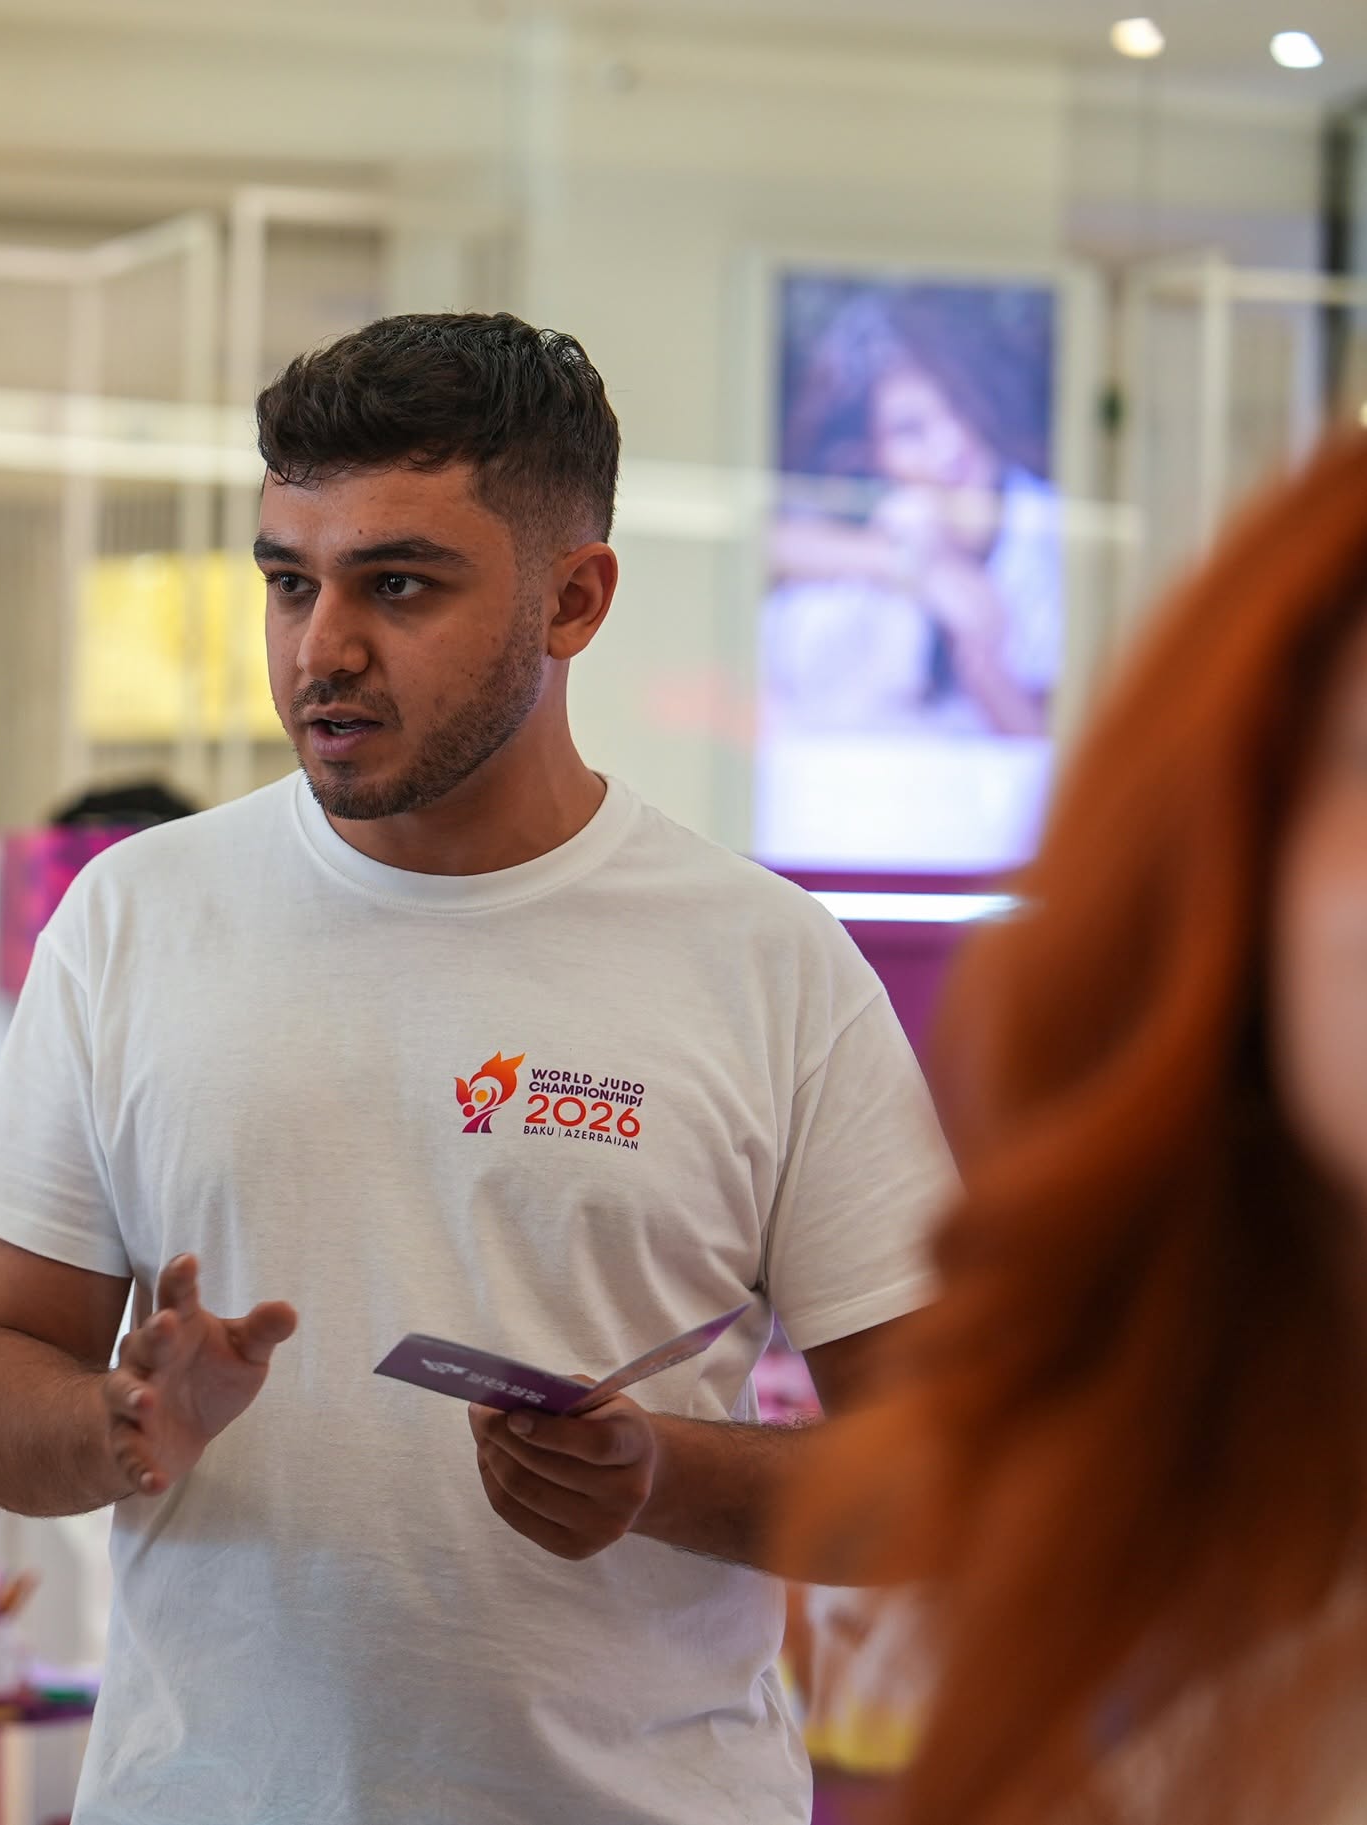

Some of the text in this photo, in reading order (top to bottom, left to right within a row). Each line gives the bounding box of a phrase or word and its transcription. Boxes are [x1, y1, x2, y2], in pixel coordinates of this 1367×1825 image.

[529, 1081, 643, 1107] CHAMPIONSHIPS
[531, 1068, 645, 1095] WORLD JUDO
[525, 1093, 641, 1138] 2026
[523, 1125, 639, 1150] BAKU AZERBAIJAN
